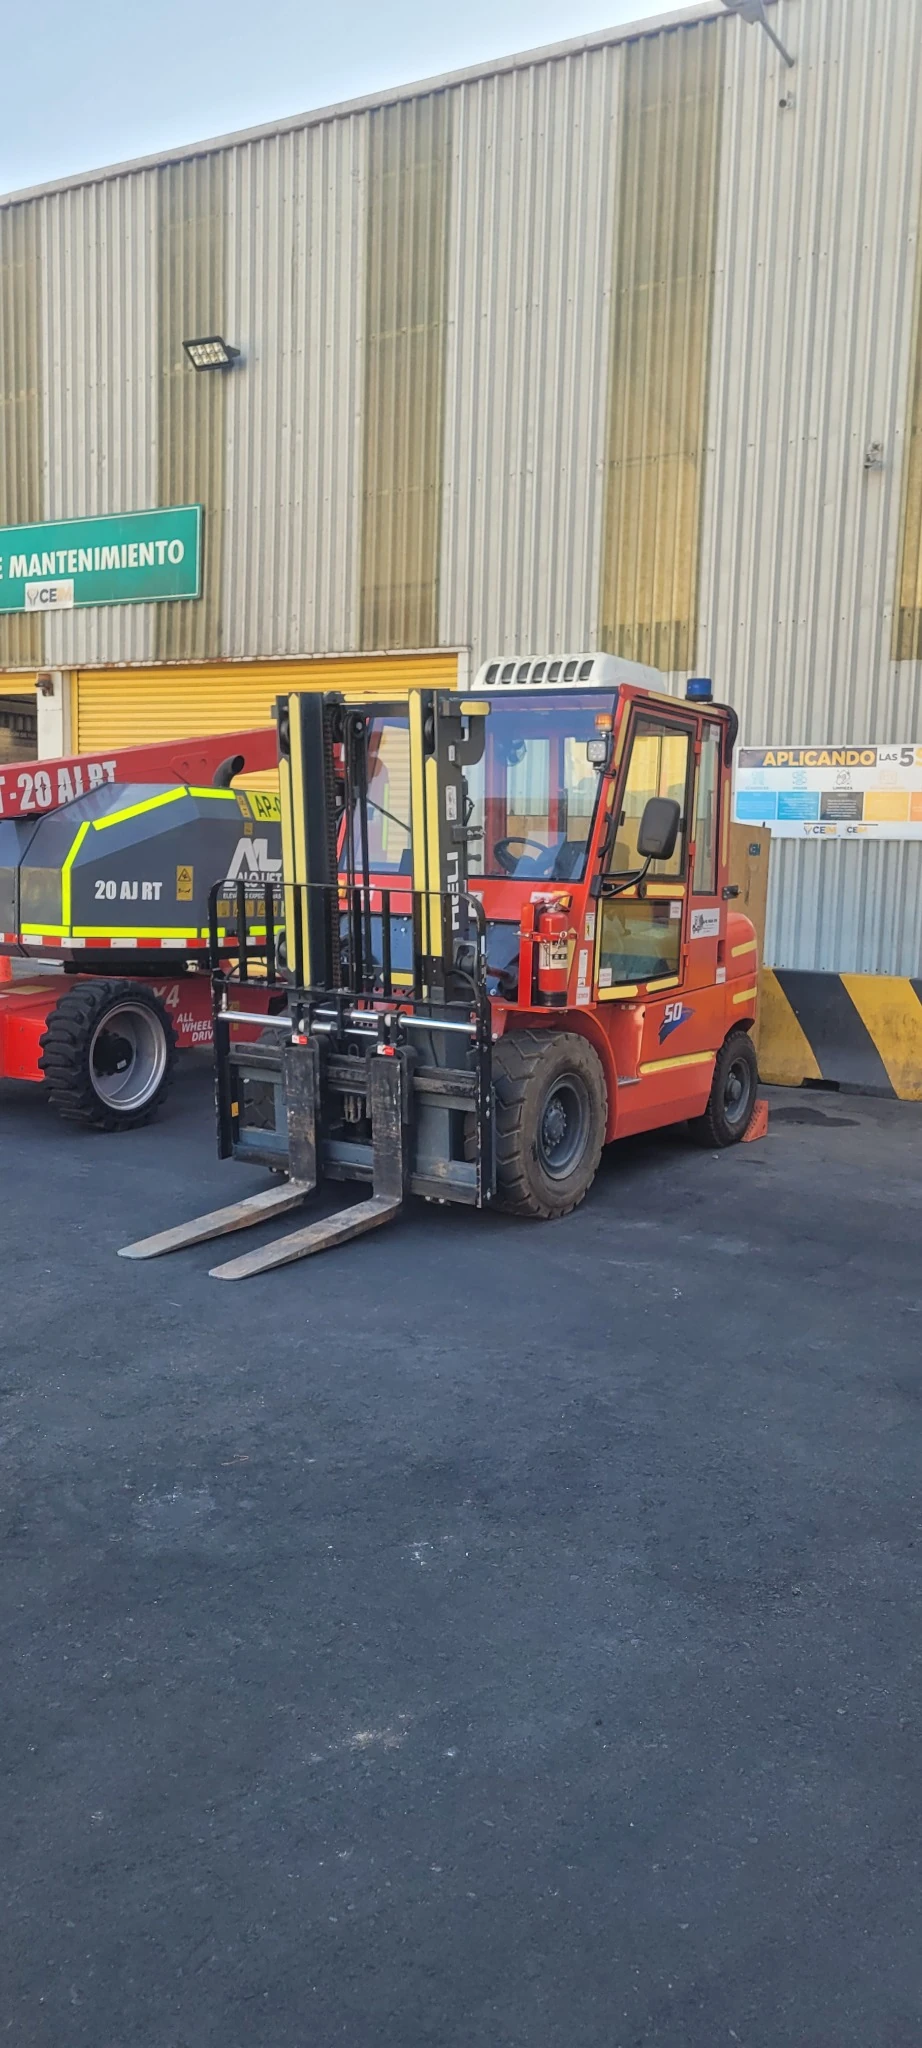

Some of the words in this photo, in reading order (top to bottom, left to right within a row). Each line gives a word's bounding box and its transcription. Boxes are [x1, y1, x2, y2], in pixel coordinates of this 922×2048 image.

[9, 539, 185, 579] MANTENIMIENTO
[762, 750, 876, 767] APLICANDO
[879, 753, 898, 761] LAS
[87, 760, 117, 791] RT
[94, 879, 117, 900] 20
[119, 880, 139, 900] AJ
[141, 881, 163, 901] RT
[446, 851, 460, 931] HELI
[176, 1012, 194, 1024] ALL
[663, 1002, 684, 1024] 50
[181, 1019, 213, 1033] WHEEL
[191, 1030, 214, 1042] DRIV
